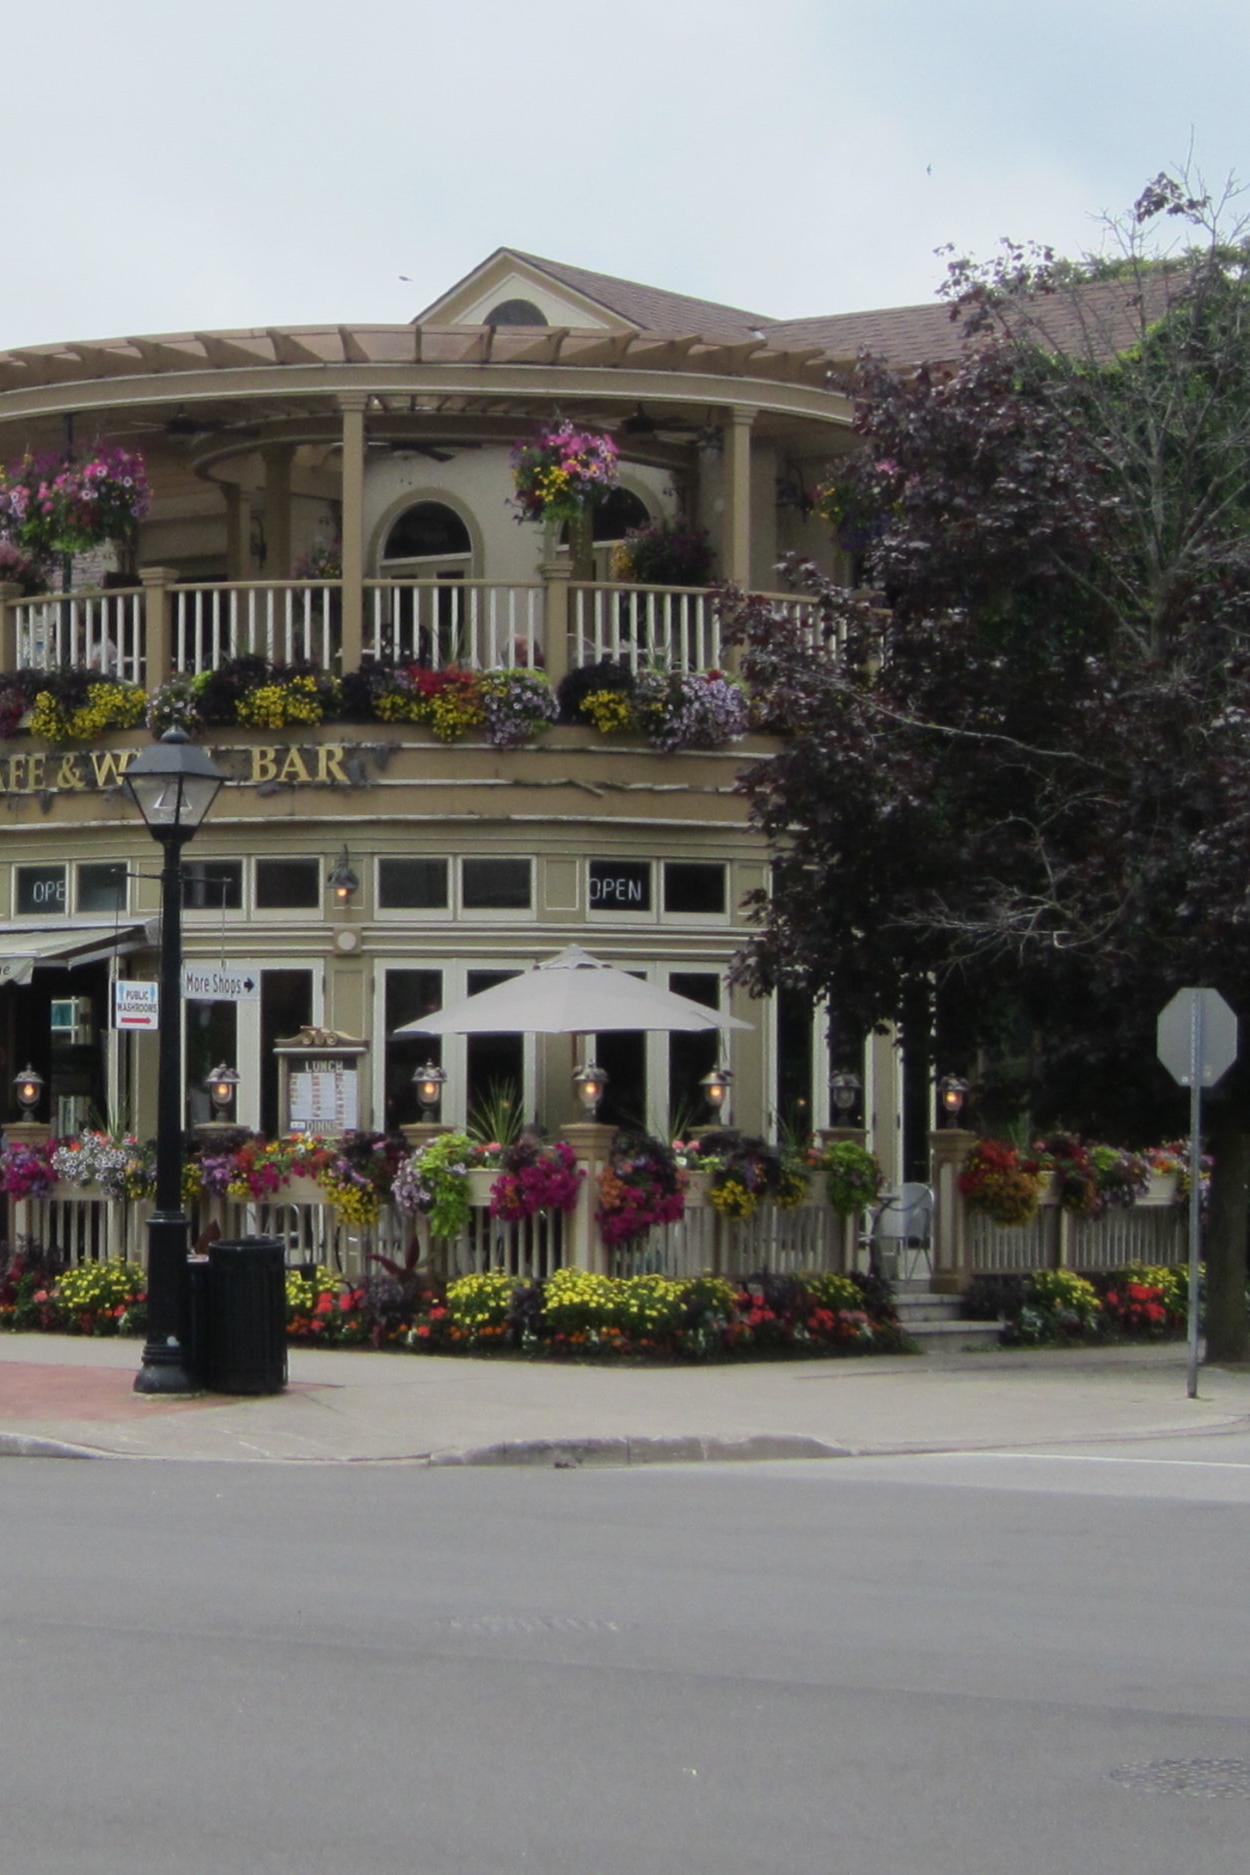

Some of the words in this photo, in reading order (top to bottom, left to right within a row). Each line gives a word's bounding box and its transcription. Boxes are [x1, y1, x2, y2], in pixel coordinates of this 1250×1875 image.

[56, 752, 86, 788] &
[251, 745, 348, 783] BAR
[589, 877, 642, 901] OPEN
[186, 973, 210, 993] More
[213, 973, 242, 998] Shops
[125, 990, 149, 1000] PUBLIC
[117, 1002, 158, 1014] WASHROOMS
[305, 1060, 344, 1073] LUNCH
